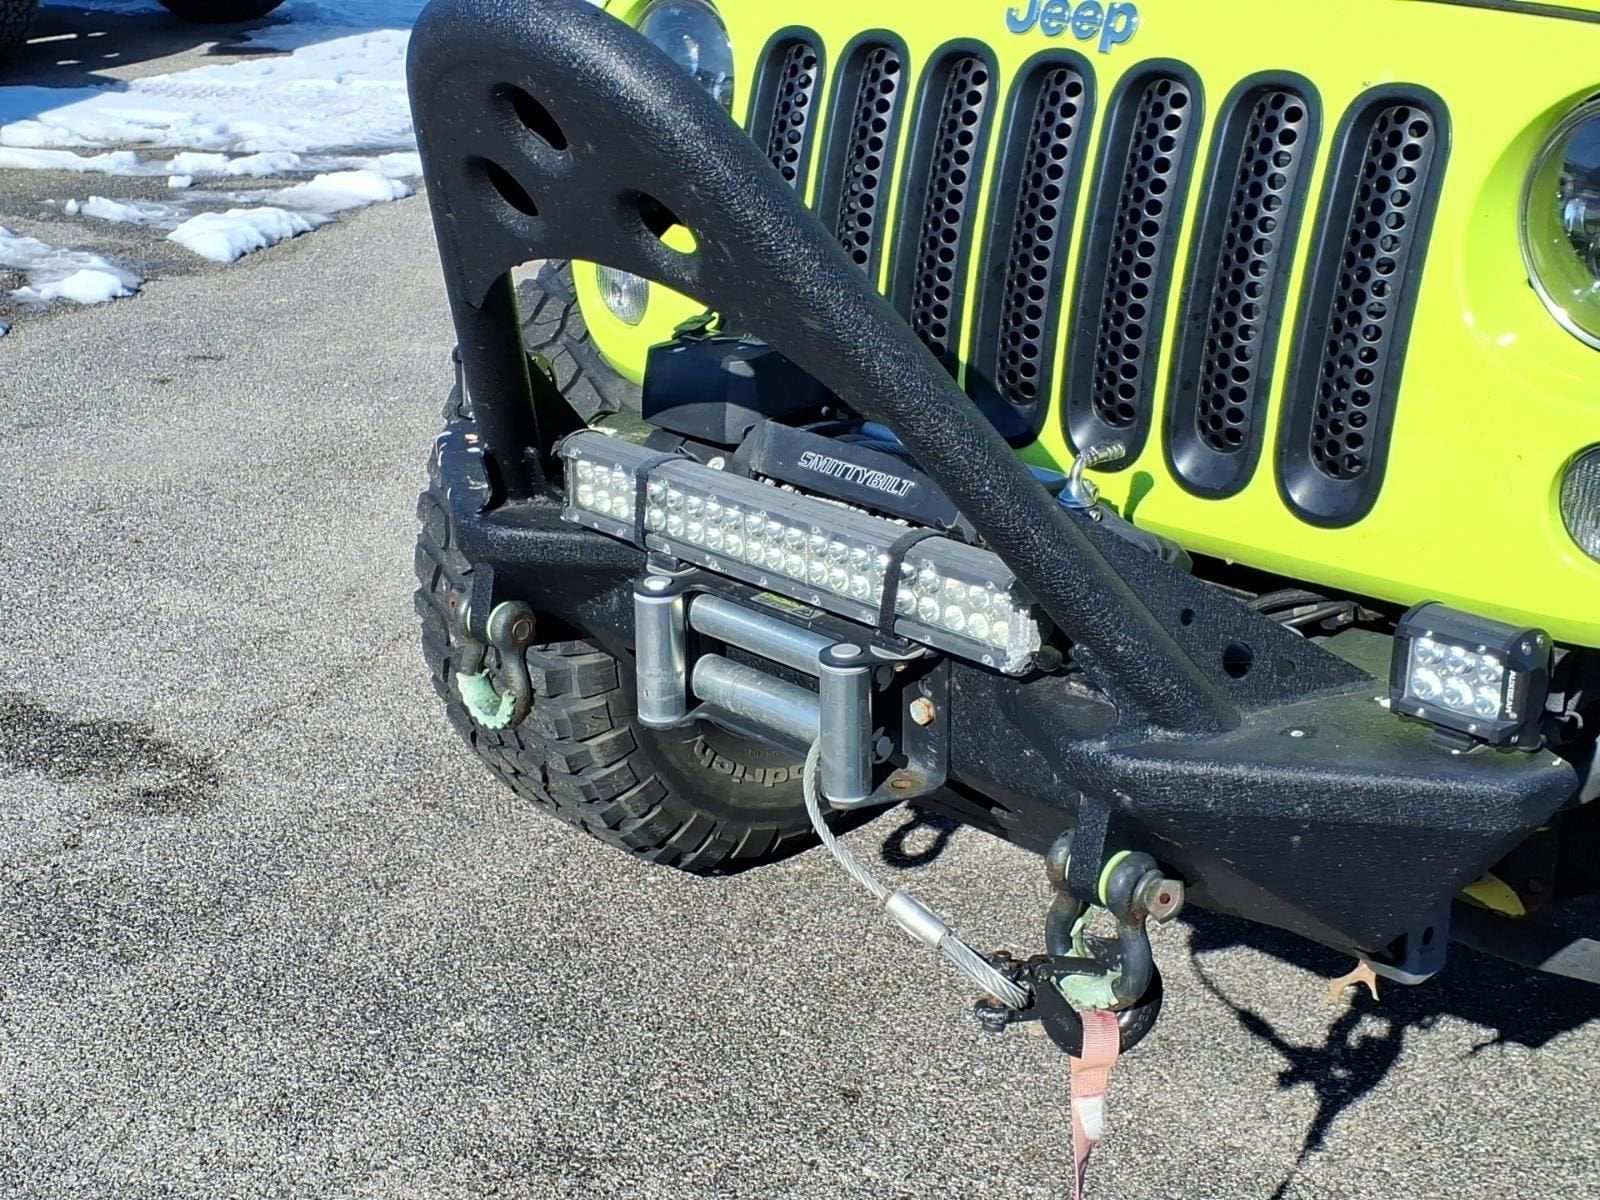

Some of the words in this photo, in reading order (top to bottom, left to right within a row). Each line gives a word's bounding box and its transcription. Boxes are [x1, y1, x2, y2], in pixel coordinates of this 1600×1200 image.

[1006, 0, 1138, 54] Jeep
[798, 451, 915, 496] SMITTYBILT
[693, 735, 804, 787] odrich
